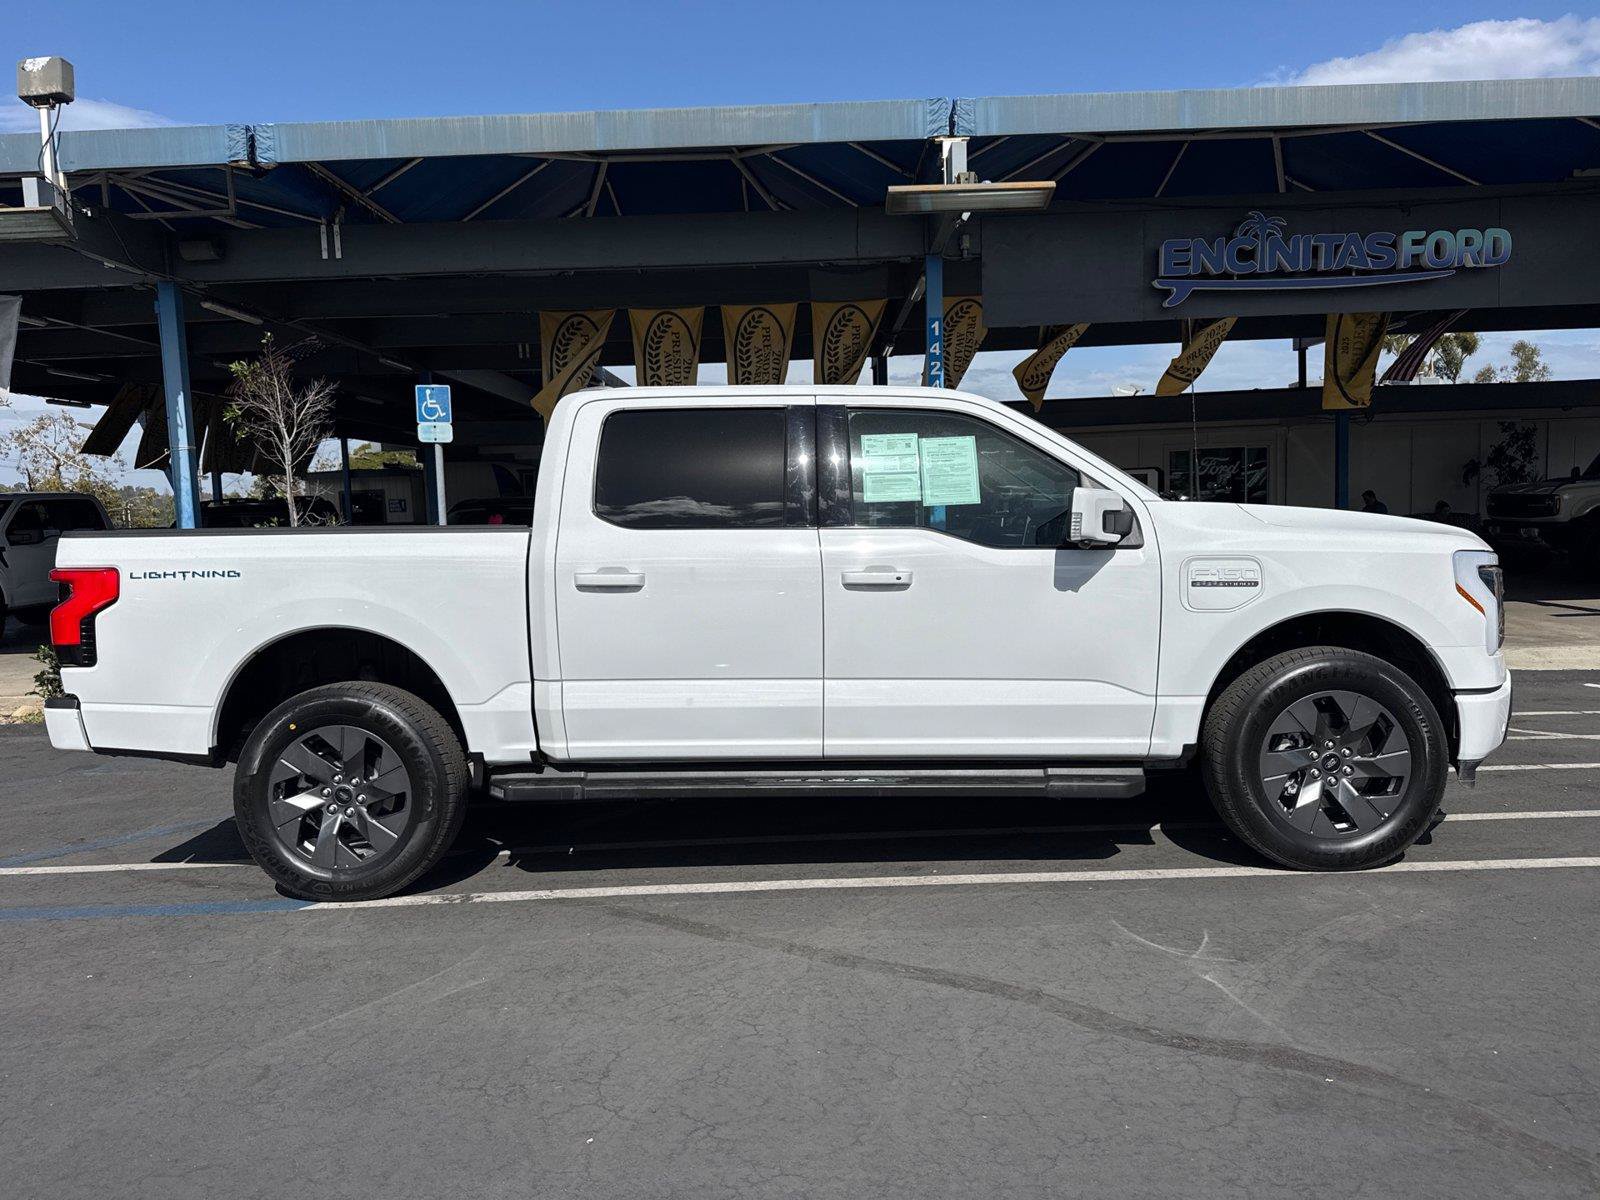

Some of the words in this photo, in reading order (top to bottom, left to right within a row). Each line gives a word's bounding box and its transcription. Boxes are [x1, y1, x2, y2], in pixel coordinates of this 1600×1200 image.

[1160, 231, 1398, 276] ENCINITAS
[1399, 227, 1513, 270] FORD
[1198, 456, 1241, 475] Ford
[129, 570, 241, 581] LIGHTNING
[1190, 567, 1259, 580] F-150
